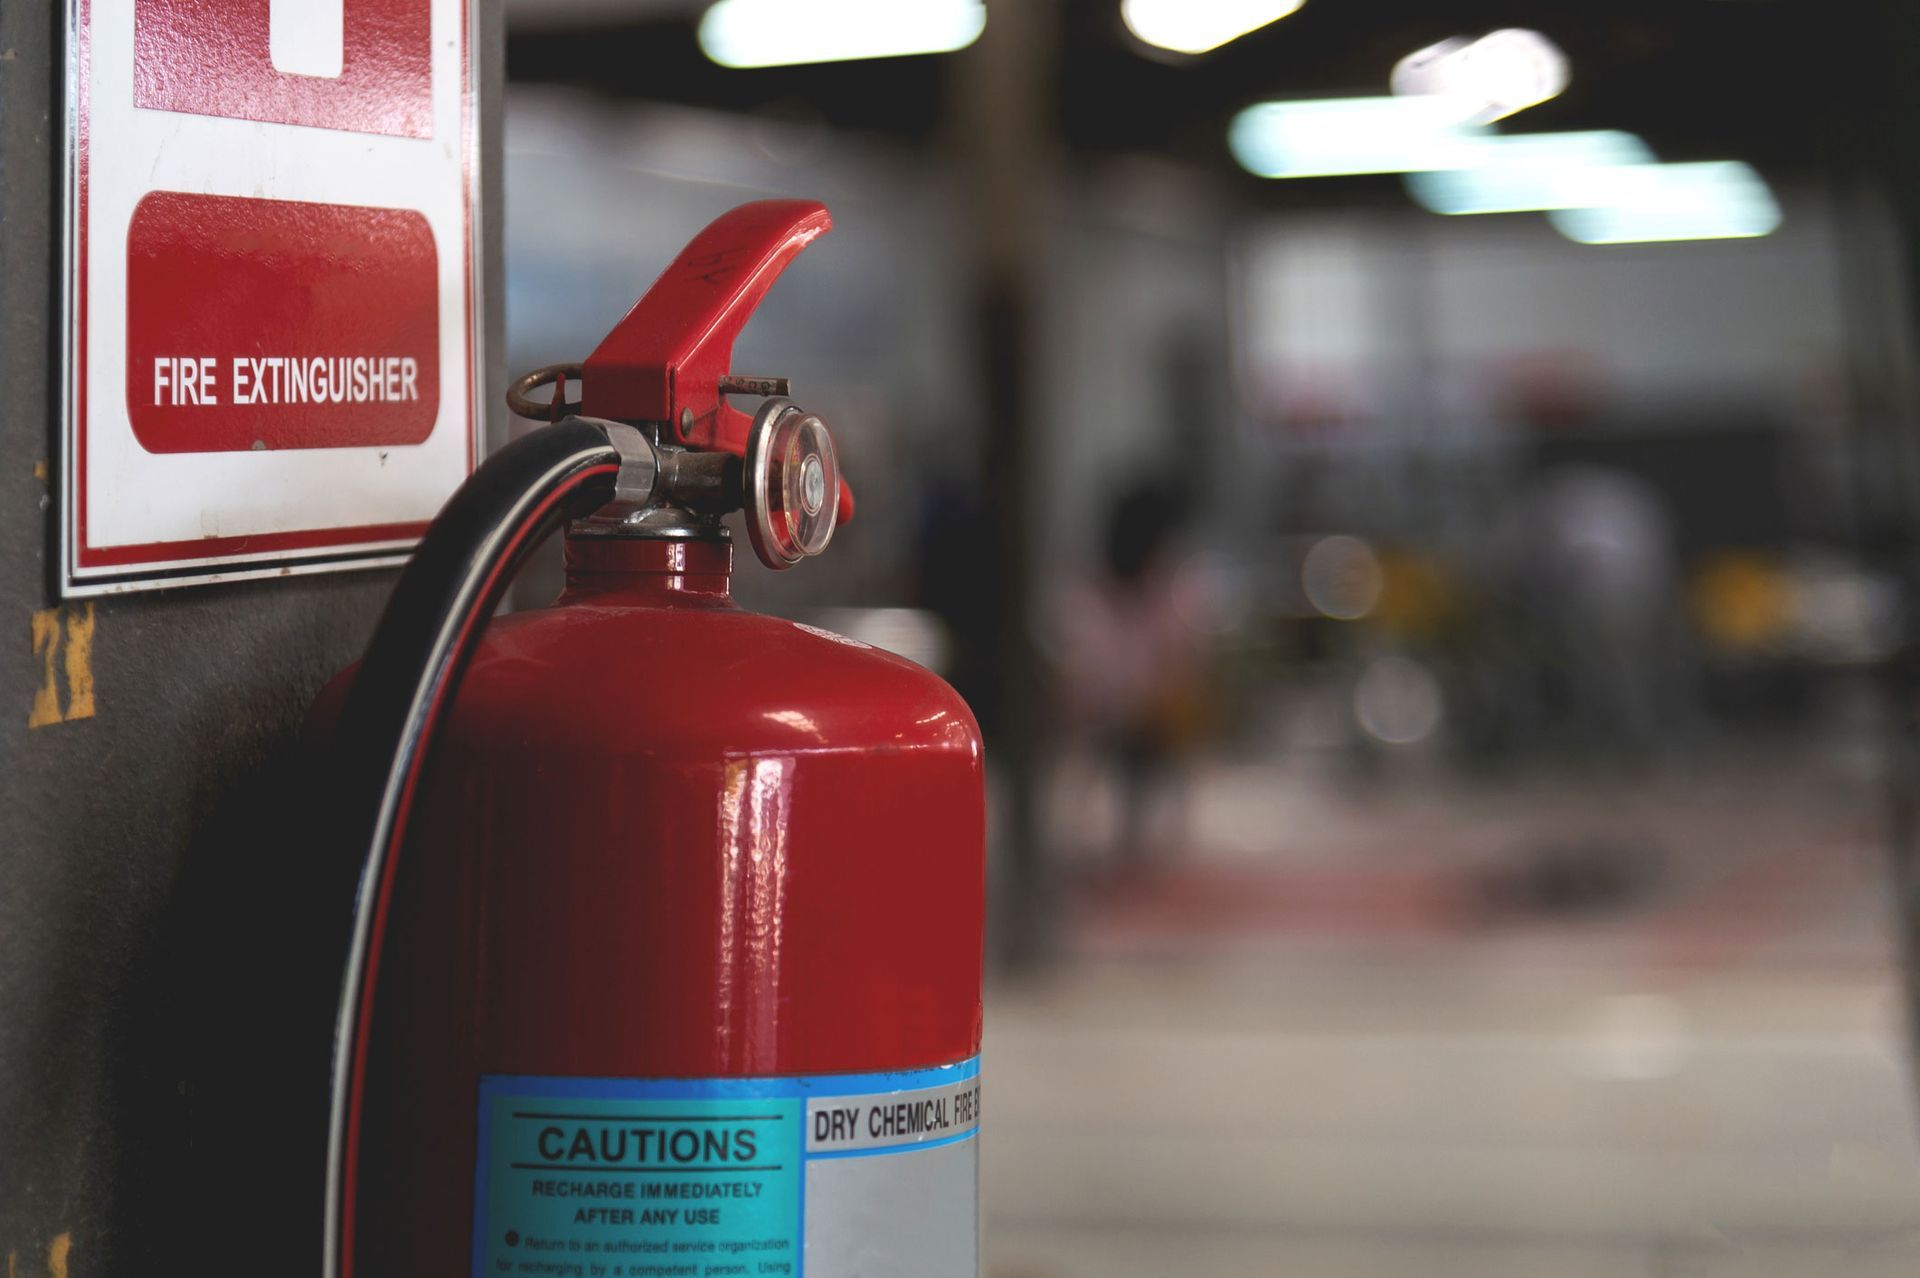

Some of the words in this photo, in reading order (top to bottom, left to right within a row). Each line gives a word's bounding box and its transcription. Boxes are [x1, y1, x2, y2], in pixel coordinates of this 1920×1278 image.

[154, 357, 217, 406] FIRE
[233, 356, 419, 405] EXTINGUISHER
[815, 1109, 860, 1142] DRY
[869, 1098, 949, 1139] CHEMICAL
[955, 1090, 972, 1126] FIRE
[538, 1127, 757, 1162] CAUTIONS
[532, 1179, 635, 1199] RECHARGE
[641, 1181, 763, 1199] IMMEDIATELY
[574, 1207, 634, 1225] AFTER
[640, 1207, 679, 1225] ANY
[684, 1207, 720, 1225] USE
[525, 1236, 565, 1250] Return
[568, 1240, 580, 1252] to
[584, 1242, 598, 1252] an
[602, 1240, 669, 1253] authorized
[672, 1240, 715, 1253] service
[719, 1238, 789, 1255] organization
[518, 1262, 583, 1277] recharging
[590, 1263, 605, 1278] by
[613, 1265, 623, 1276] a
[628, 1264, 698, 1277] competent
[757, 1261, 791, 1275] Using
